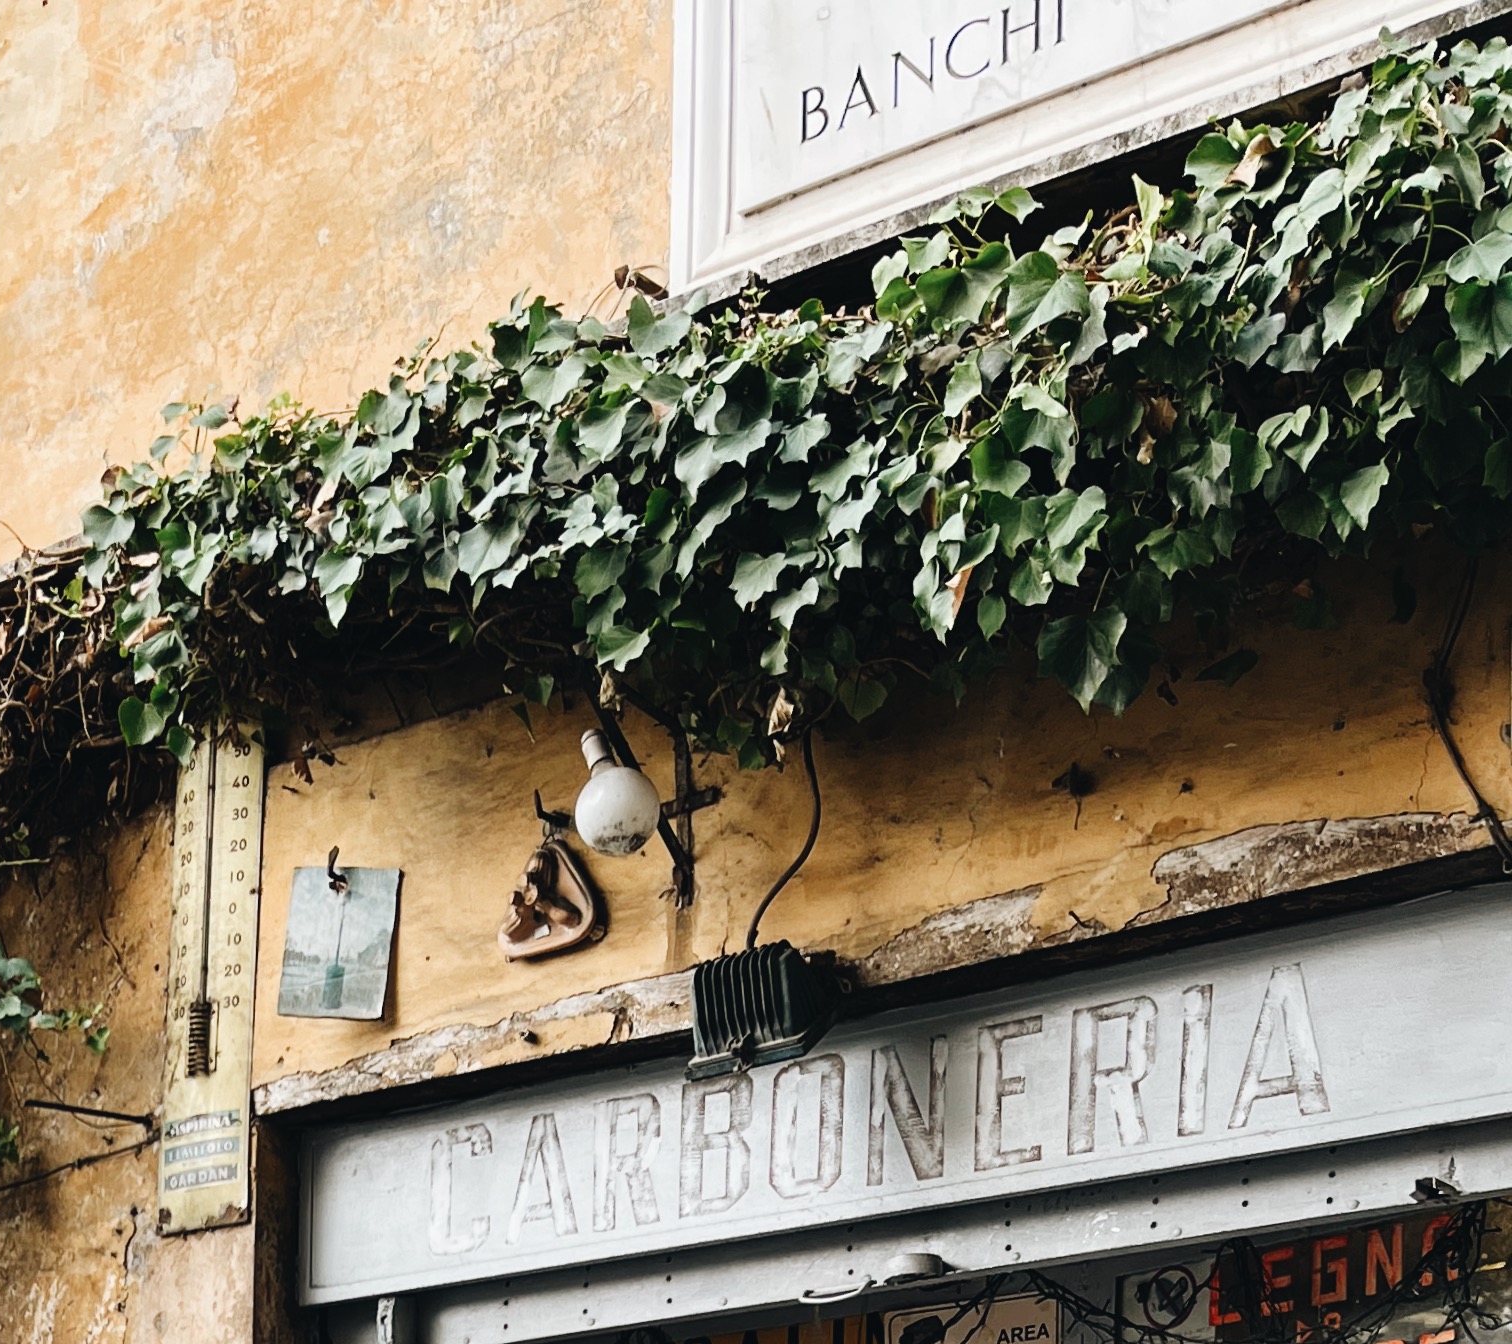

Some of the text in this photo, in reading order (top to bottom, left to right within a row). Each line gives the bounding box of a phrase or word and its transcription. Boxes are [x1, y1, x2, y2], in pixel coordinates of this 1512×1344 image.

[799, 0, 1067, 144] BANCHI
[232, 775, 250, 788] 40
[232, 807, 248, 820] 30
[230, 838, 247, 853] 20
[230, 870, 245, 883] 10
[229, 902, 237, 914] 0
[227, 933, 242, 946] 10
[224, 963, 241, 977] 20
[223, 994, 240, 1008] 30
[428, 961, 1331, 1257] CARBONERIA
